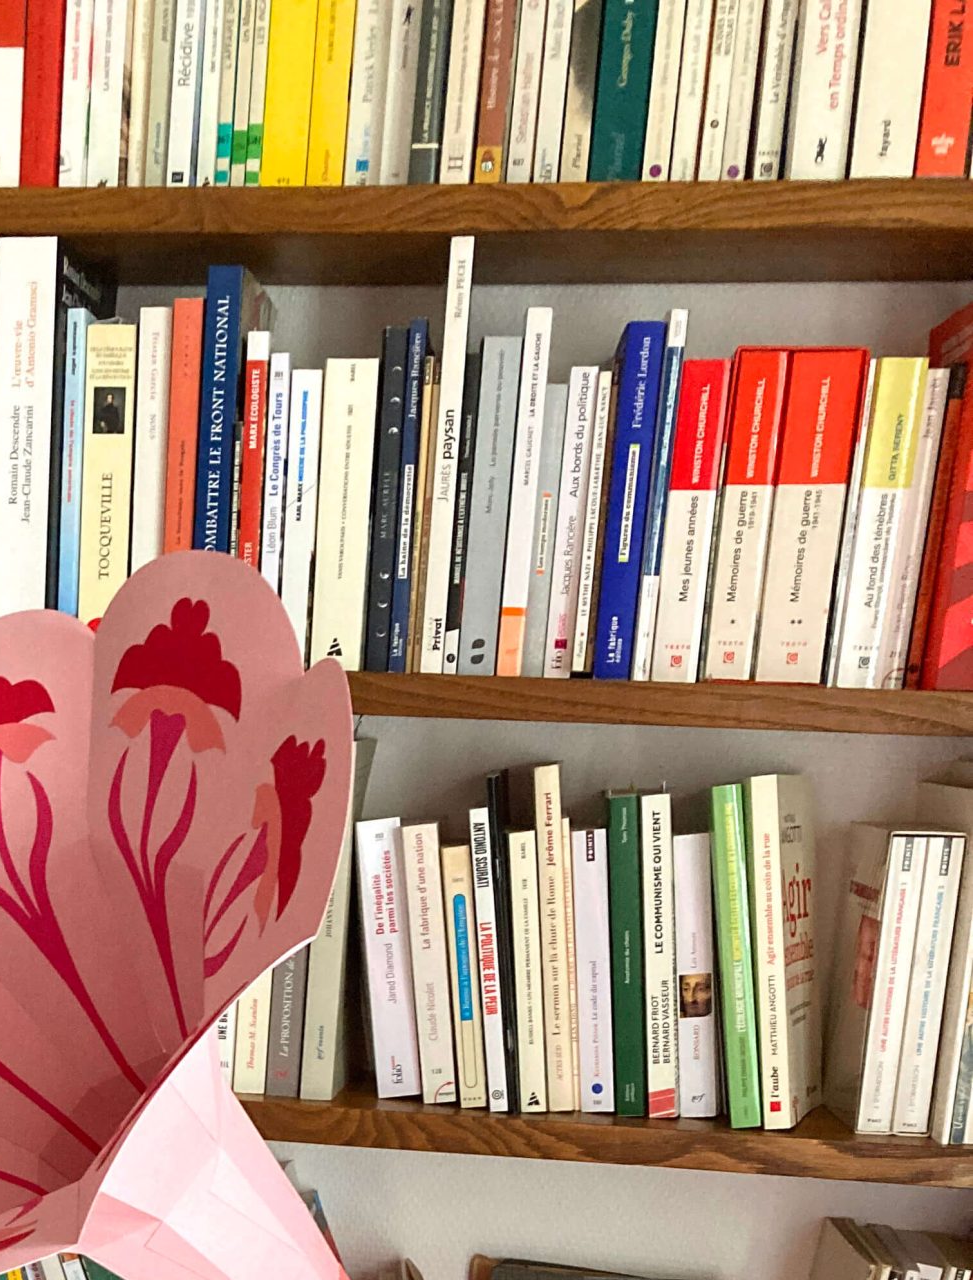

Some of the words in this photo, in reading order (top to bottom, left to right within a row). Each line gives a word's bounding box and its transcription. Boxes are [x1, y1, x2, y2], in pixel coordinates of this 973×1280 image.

[177, 23, 195, 87] Récidive
[944, 21, 962, 67] ERIK
[214, 295, 230, 381] NATIONAL
[273, 392, 283, 421] Tours
[409, 380, 421, 419] Jacques
[574, 372, 591, 421] politique
[695, 384, 710, 439] CHURCHILL
[751, 378, 765, 433] CHURCHILL
[815, 377, 830, 432] CHURCHILL
[10, 405, 21, 460] Descendre
[22, 405, 34, 456] Zancarini
[210, 389, 224, 441] FRONT
[273, 424, 282, 436] de
[573, 424, 584, 439] du
[209, 447, 221, 464] LE
[269, 439, 283, 481] Congrès
[571, 442, 583, 473] bords
[10, 463, 20, 505] Romain
[21, 459, 32, 523] Jean-Claude
[269, 484, 279, 496] Le
[569, 476, 579, 498] Aux
[99, 473, 113, 579] TOCQUEVILLE
[206, 470, 221, 553] OMBATTRE
[267, 507, 278, 533] Blum
[685, 496, 698, 536] années
[734, 491, 749, 527] guerre
[798, 490, 813, 527] guerre
[266, 535, 277, 554] Léon
[562, 515, 577, 556] Rancière
[731, 530, 744, 545] de
[795, 530, 807, 545] de
[680, 540, 694, 575] jeunes
[725, 549, 741, 602] Mémoires
[788, 549, 804, 602] Mémoires
[560, 559, 573, 595] Jacques
[678, 579, 690, 602] Mes
[432, 617, 443, 651] Privat
[652, 810, 661, 846] VIENT
[414, 833, 424, 864] nation
[653, 849, 662, 866] QUI
[382, 850, 393, 889] sociétés
[416, 866, 427, 893] d'une
[371, 875, 383, 920] l'inégalité
[385, 891, 395, 905] les
[653, 870, 662, 938] COMMUNISME
[376, 923, 384, 934] De
[388, 908, 398, 933] parmi
[418, 896, 432, 936] fabrique
[385, 943, 396, 979] Diamond
[422, 938, 430, 949] La
[654, 941, 663, 954] LE
[387, 981, 397, 1004] Jared
[651, 995, 660, 1021] FRIOT
[661, 979, 670, 1019] VASSEUR
[652, 1024, 661, 1064] BERNARD
[662, 1023, 671, 1064] BERNARD
